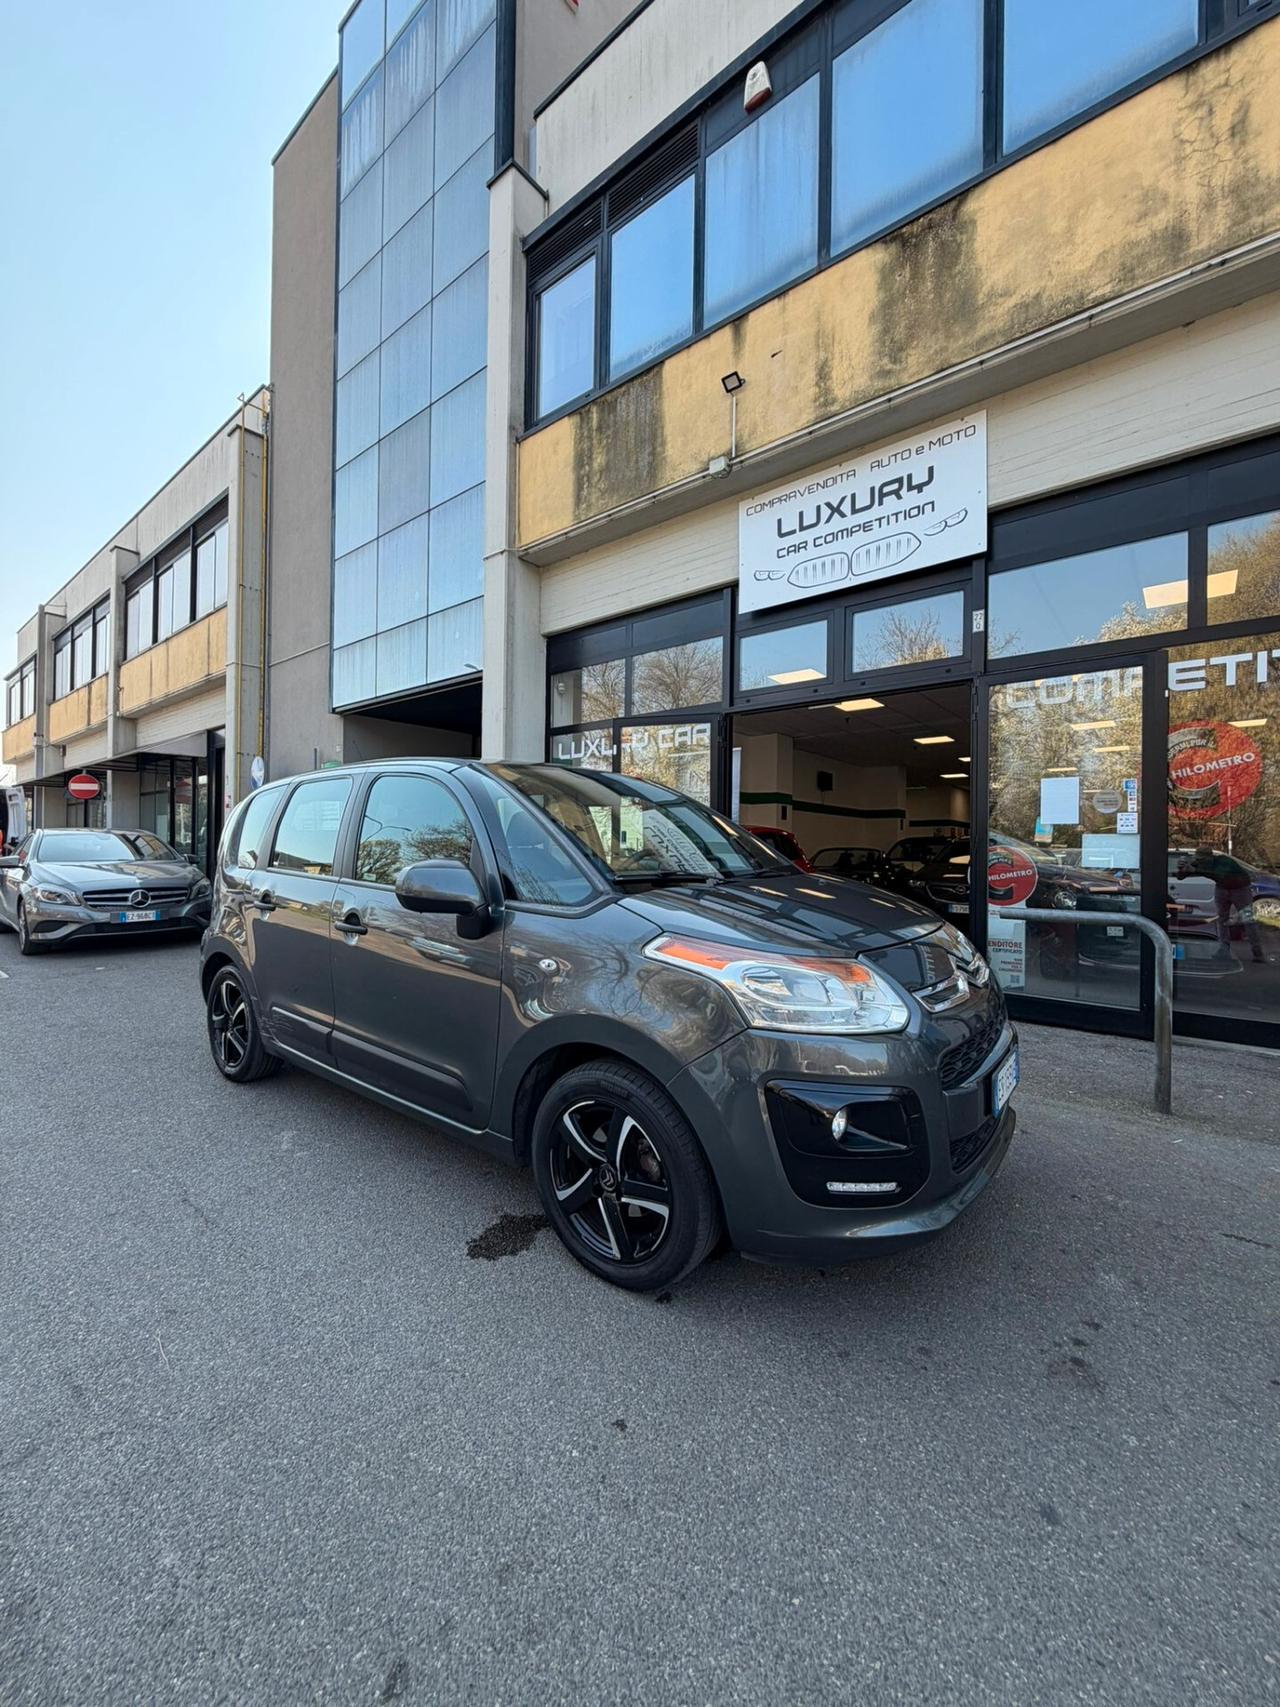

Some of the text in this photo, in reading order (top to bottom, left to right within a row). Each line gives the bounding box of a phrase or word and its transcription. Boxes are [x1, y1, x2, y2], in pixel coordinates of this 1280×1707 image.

[746, 424, 976, 517] COMPRAVENDITA AUTO e MOTO
[777, 465, 934, 539] LUXURY
[776, 500, 935, 559] CAR COMPETITION
[658, 724, 711, 749] CAR
[1171, 752, 1255, 779] HILOMETRO
[988, 869, 1033, 881] HILOMETRO
[987, 940, 1023, 949] ENDITORE
